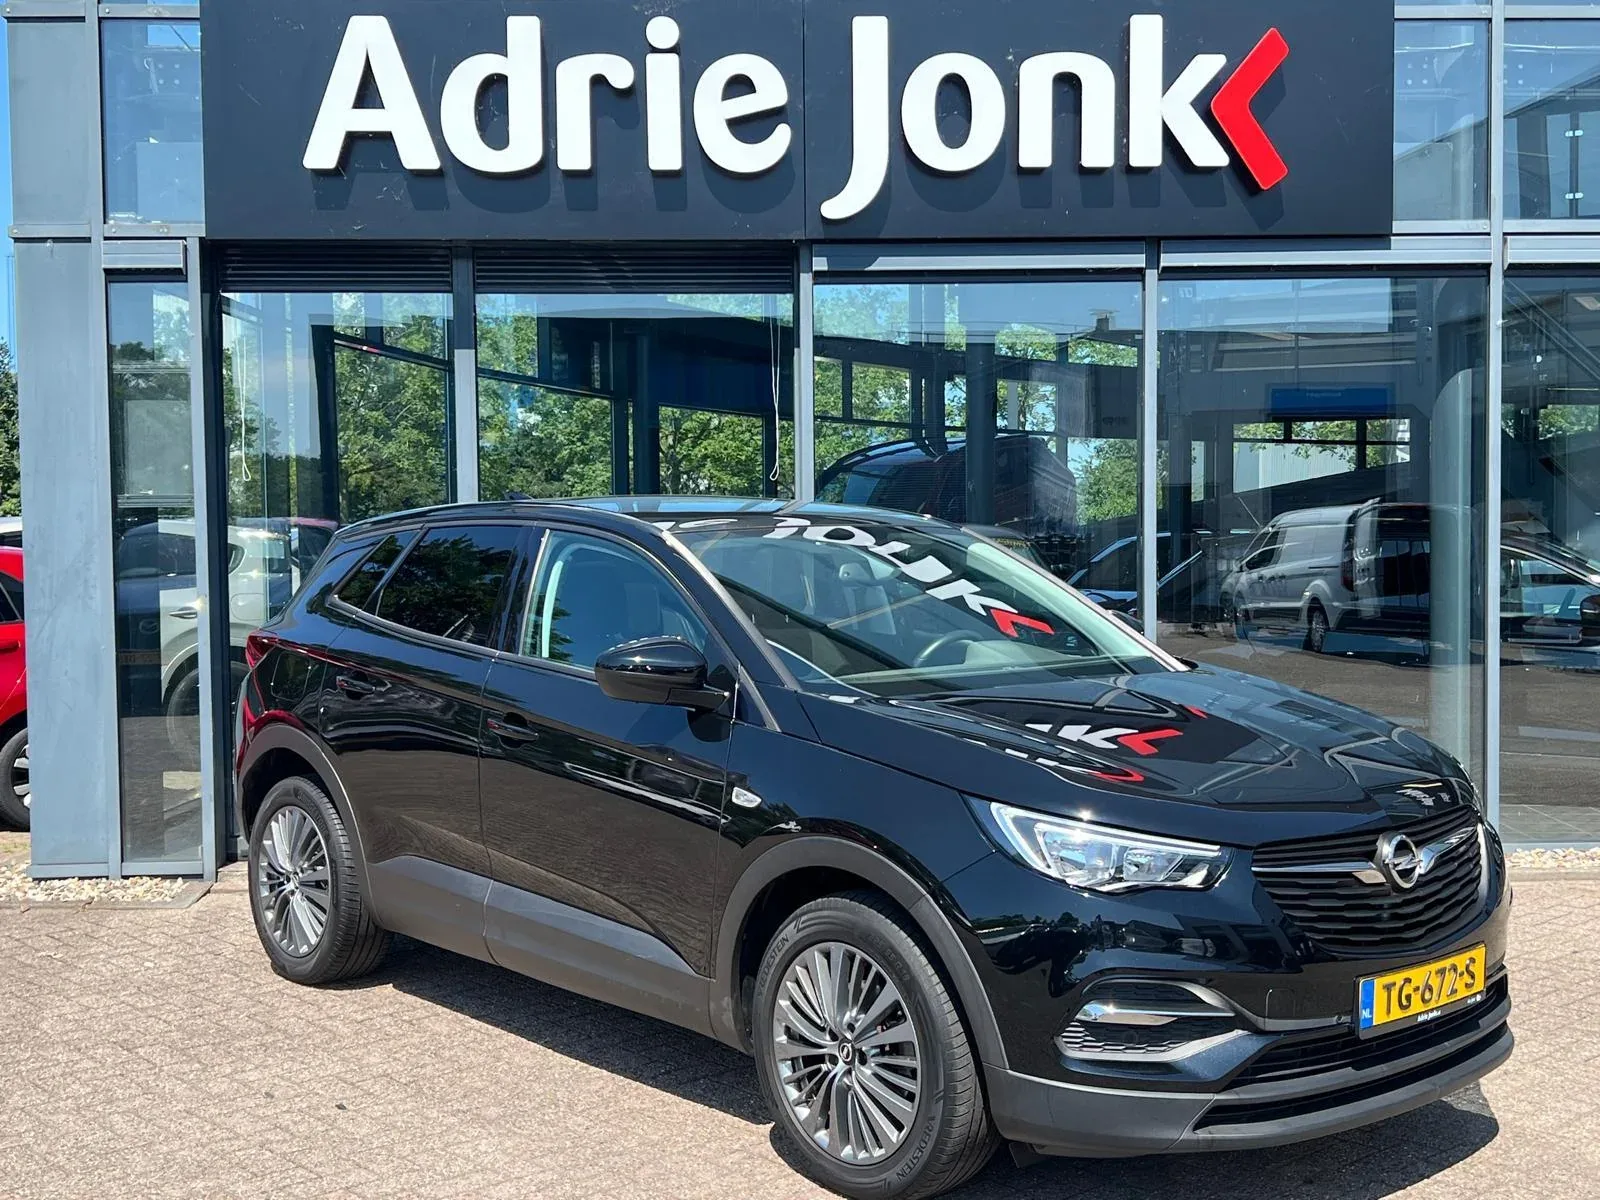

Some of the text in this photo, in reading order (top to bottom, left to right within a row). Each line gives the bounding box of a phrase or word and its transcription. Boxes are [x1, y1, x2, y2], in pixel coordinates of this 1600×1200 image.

[303, 14, 1230, 220] Adrie Jonk
[1362, 1009, 1372, 1019] NL
[1382, 957, 1476, 1018] TG-672-S
[896, 1116, 936, 1181] VREDESTEIN
